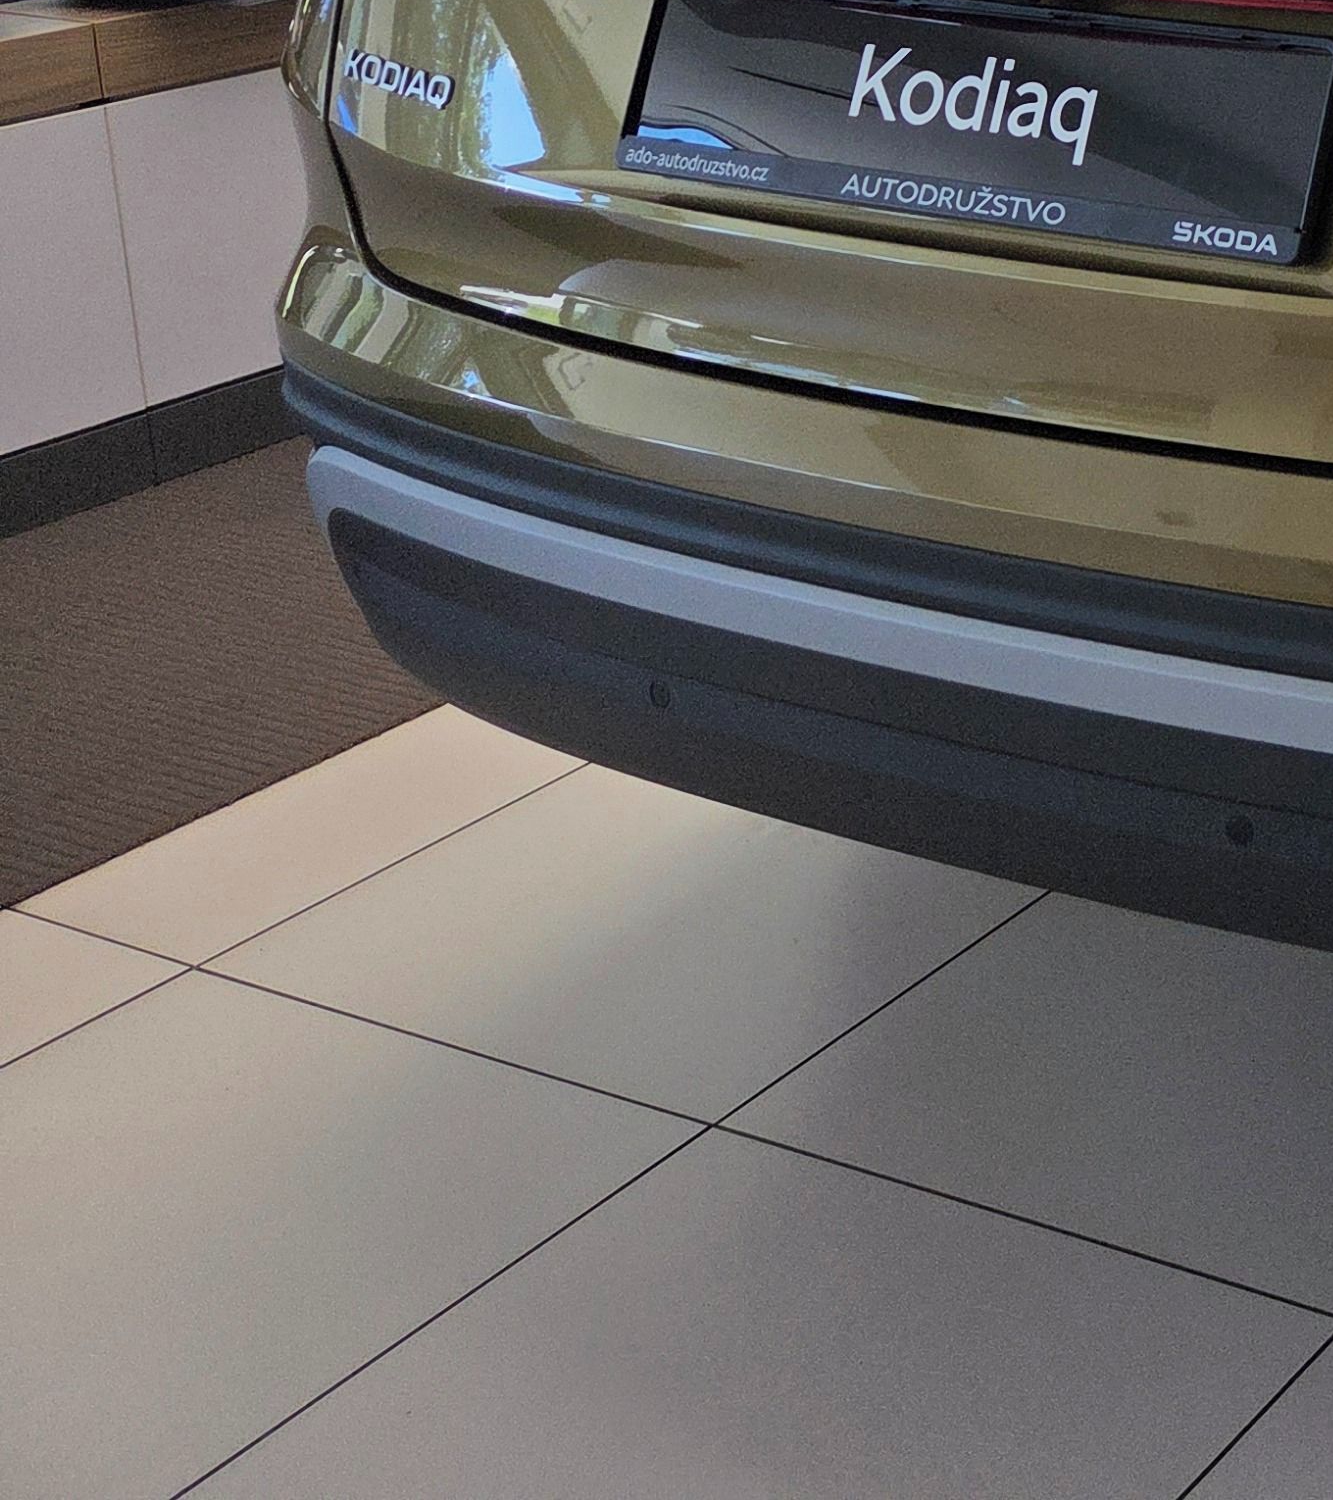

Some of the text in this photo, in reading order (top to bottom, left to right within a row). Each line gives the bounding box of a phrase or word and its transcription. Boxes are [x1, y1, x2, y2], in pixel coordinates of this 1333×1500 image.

[343, 49, 454, 110] KODIAQ
[848, 43, 1098, 166] Kodiaq
[624, 145, 770, 182] ado-autodruzstvo.cz
[840, 173, 1067, 226] AUTODRUŽSTVO
